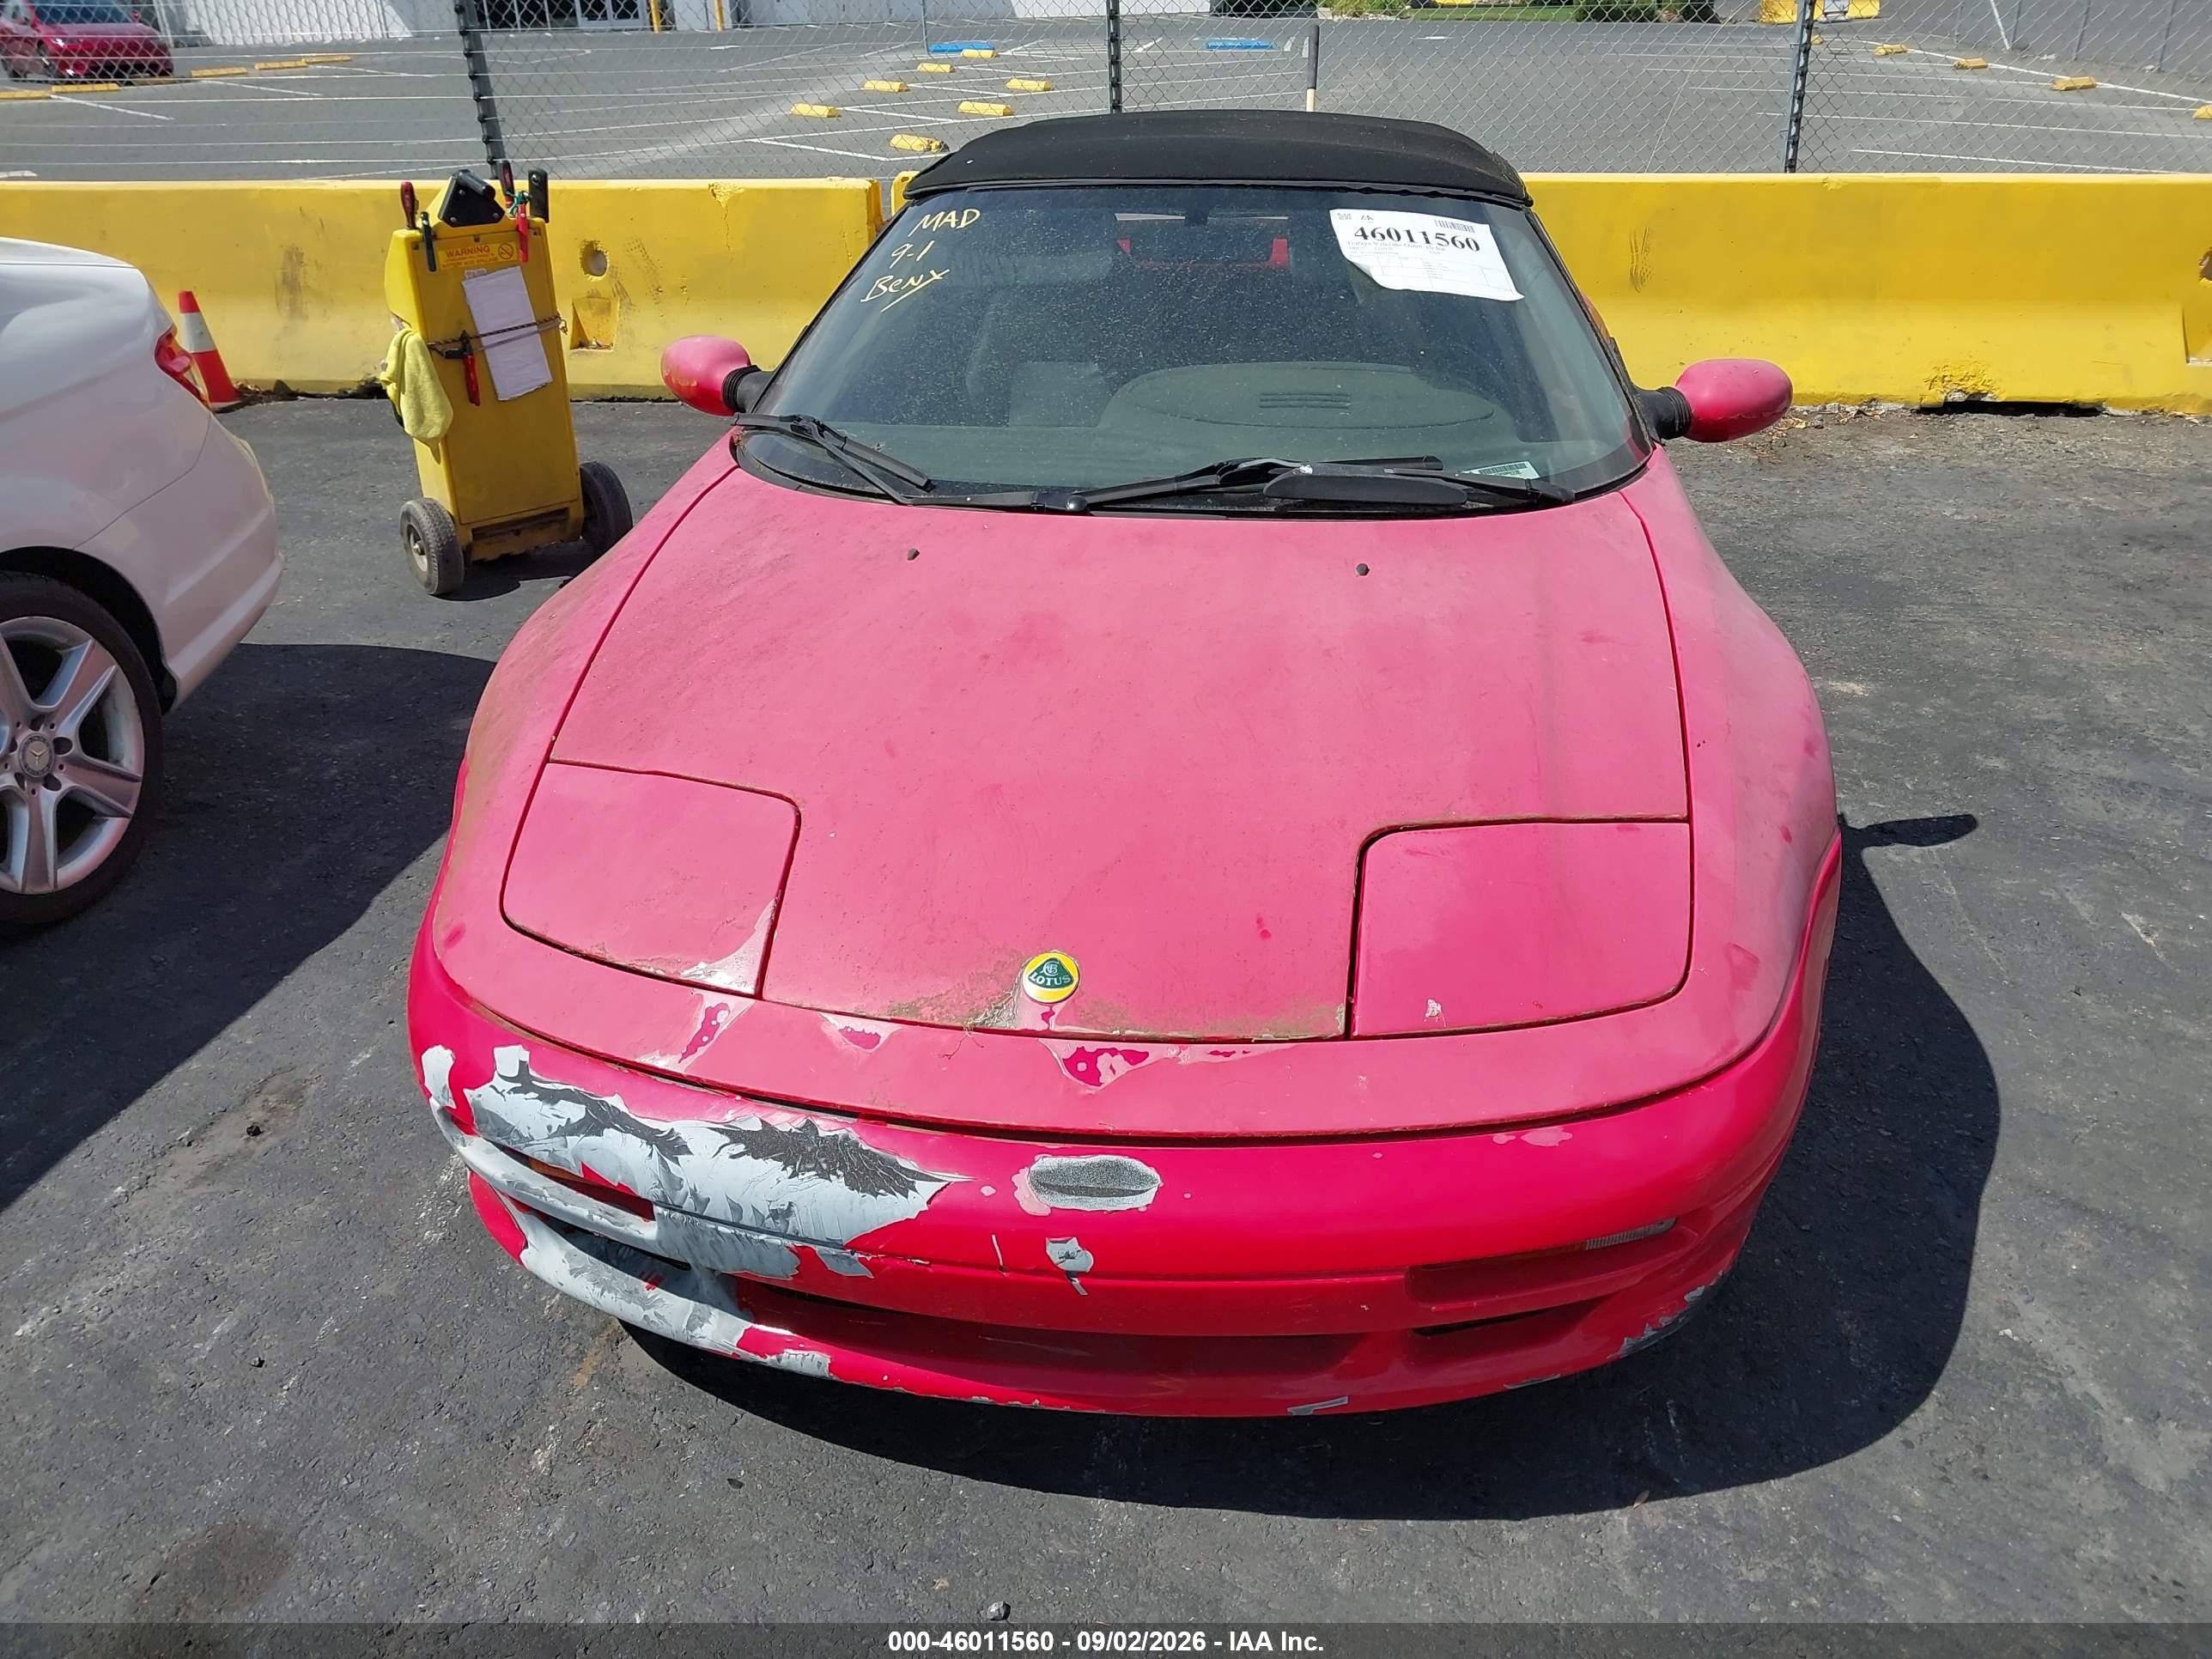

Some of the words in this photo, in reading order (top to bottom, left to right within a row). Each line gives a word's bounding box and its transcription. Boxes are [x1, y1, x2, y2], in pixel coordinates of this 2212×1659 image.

[908, 209, 981, 237] MAD
[1354, 226, 1480, 252] 46011560
[447, 246, 490, 258] WARNING
[1030, 972, 1071, 986] LOTUS
